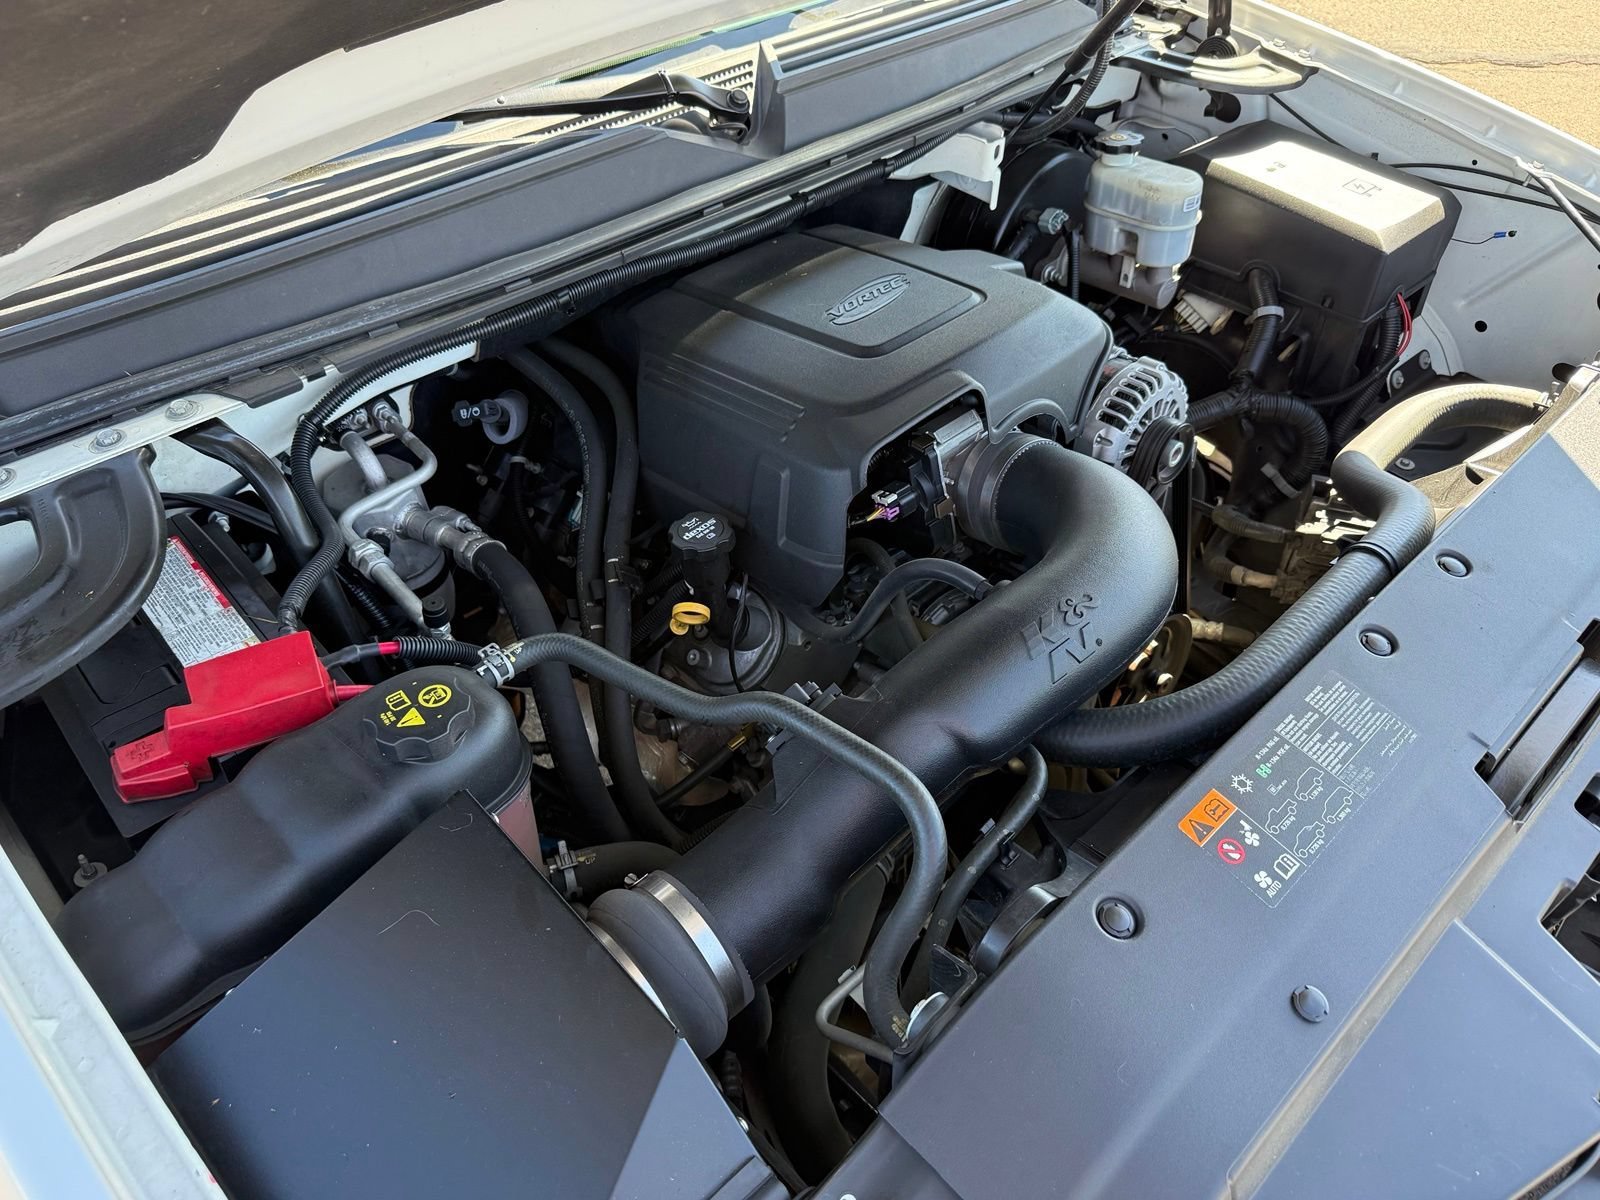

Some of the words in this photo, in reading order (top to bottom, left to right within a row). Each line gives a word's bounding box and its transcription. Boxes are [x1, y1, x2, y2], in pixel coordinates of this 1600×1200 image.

[826, 274, 911, 319] VORTEC
[683, 518, 716, 540] dexos
[1266, 880, 1282, 898] AUTO
